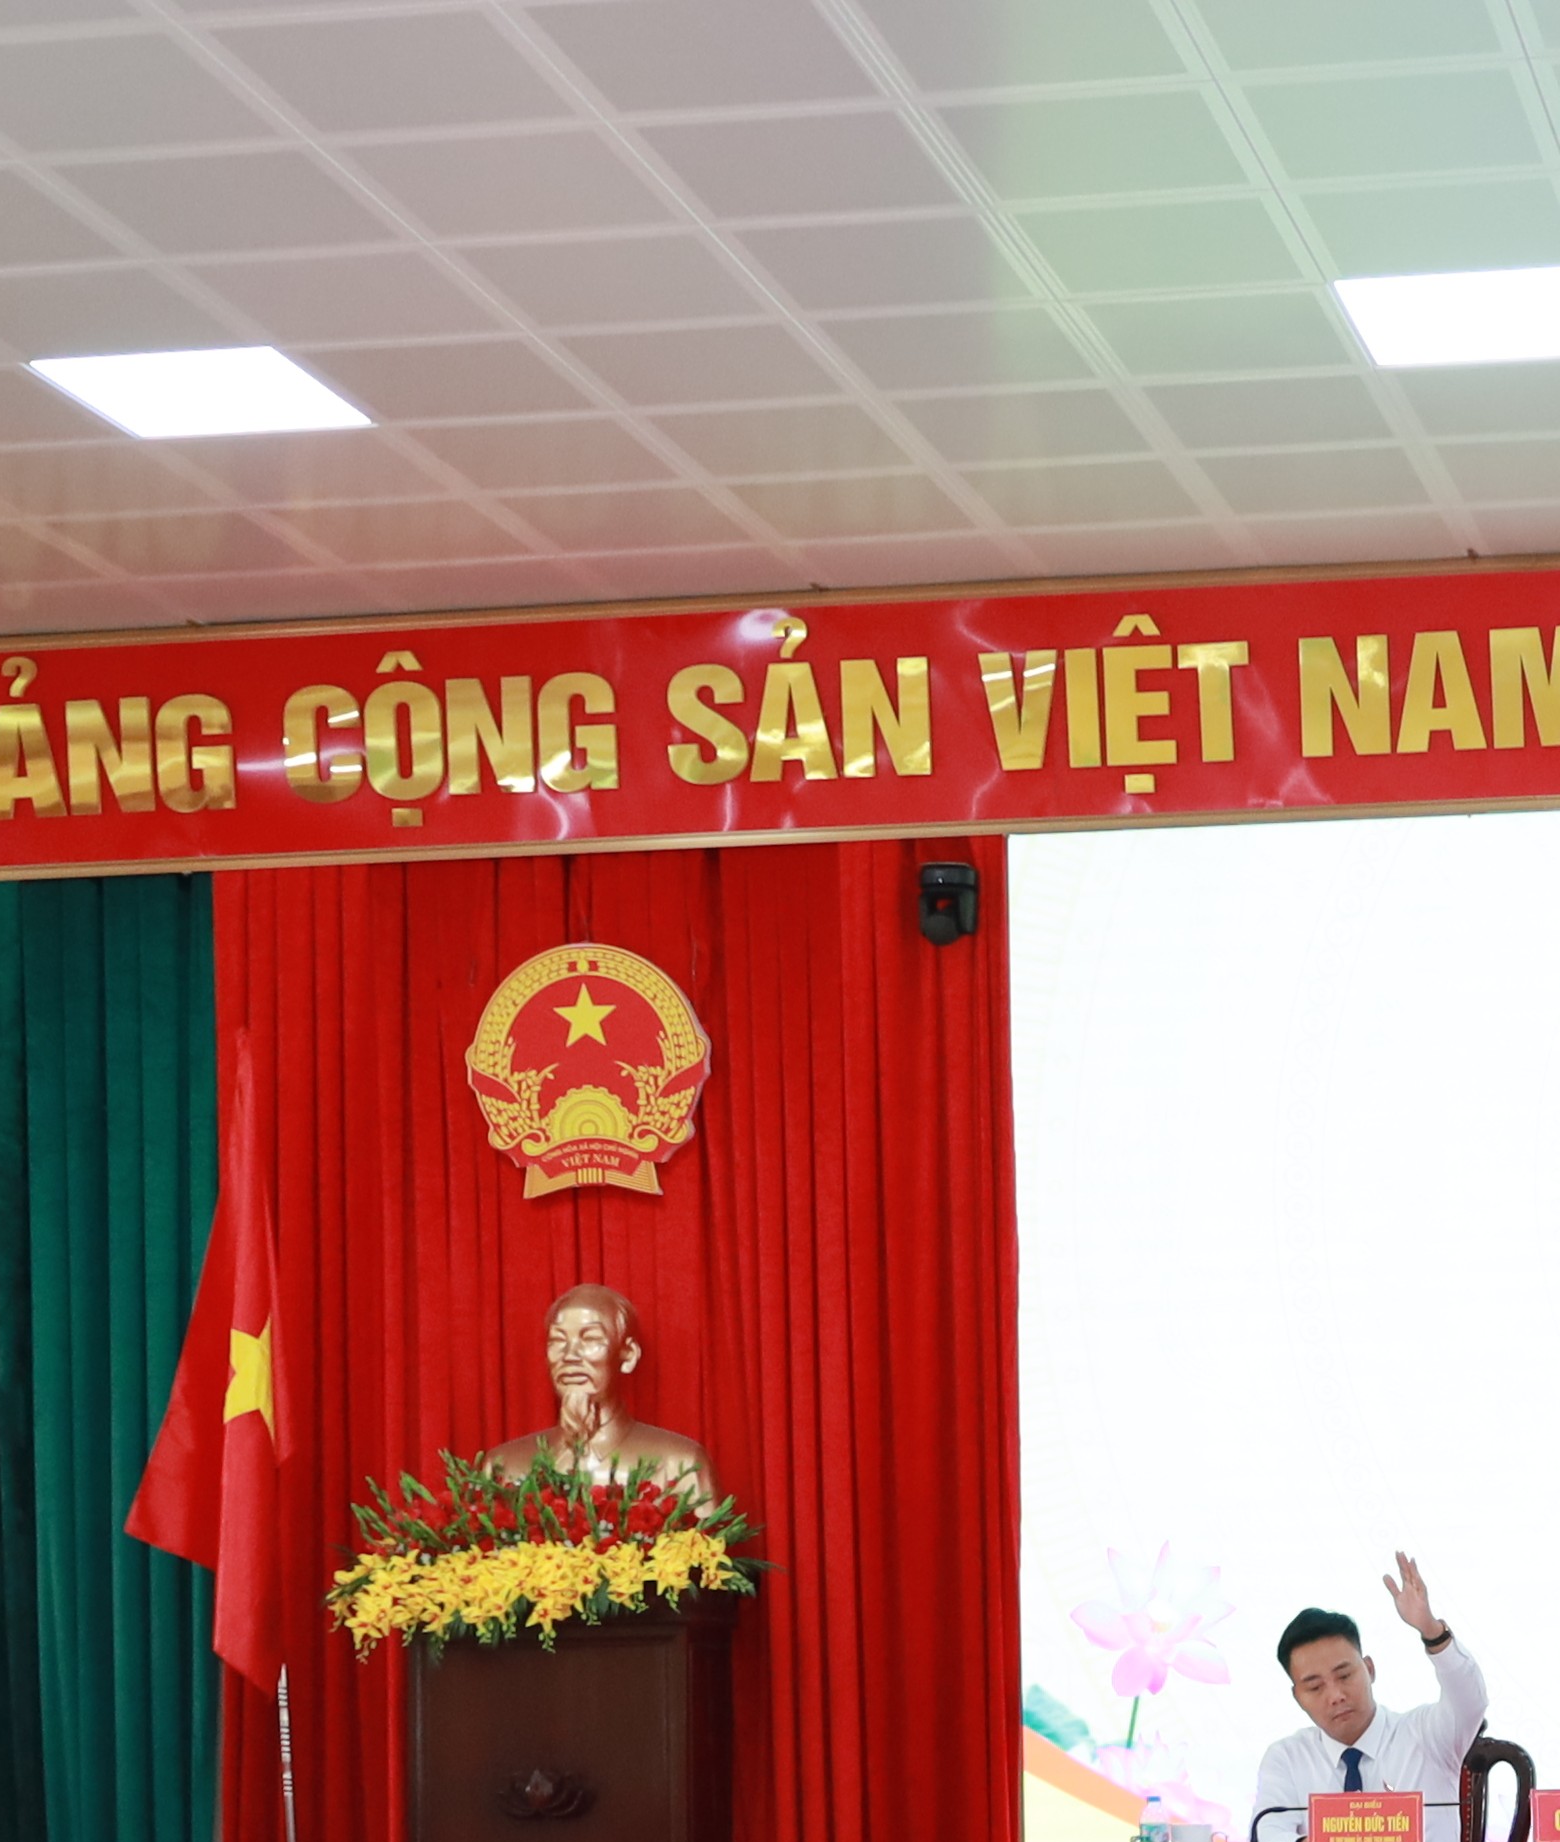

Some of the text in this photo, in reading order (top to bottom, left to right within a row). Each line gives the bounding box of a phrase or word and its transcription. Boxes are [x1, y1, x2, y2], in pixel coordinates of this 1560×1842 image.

[283, 650, 620, 827] CỘNG
[667, 616, 934, 786] SẢN
[978, 613, 1250, 794] VIỆT
[1364, 1812, 1385, 1832] ĐỨC
[1387, 1810, 1410, 1832] TIẾN
